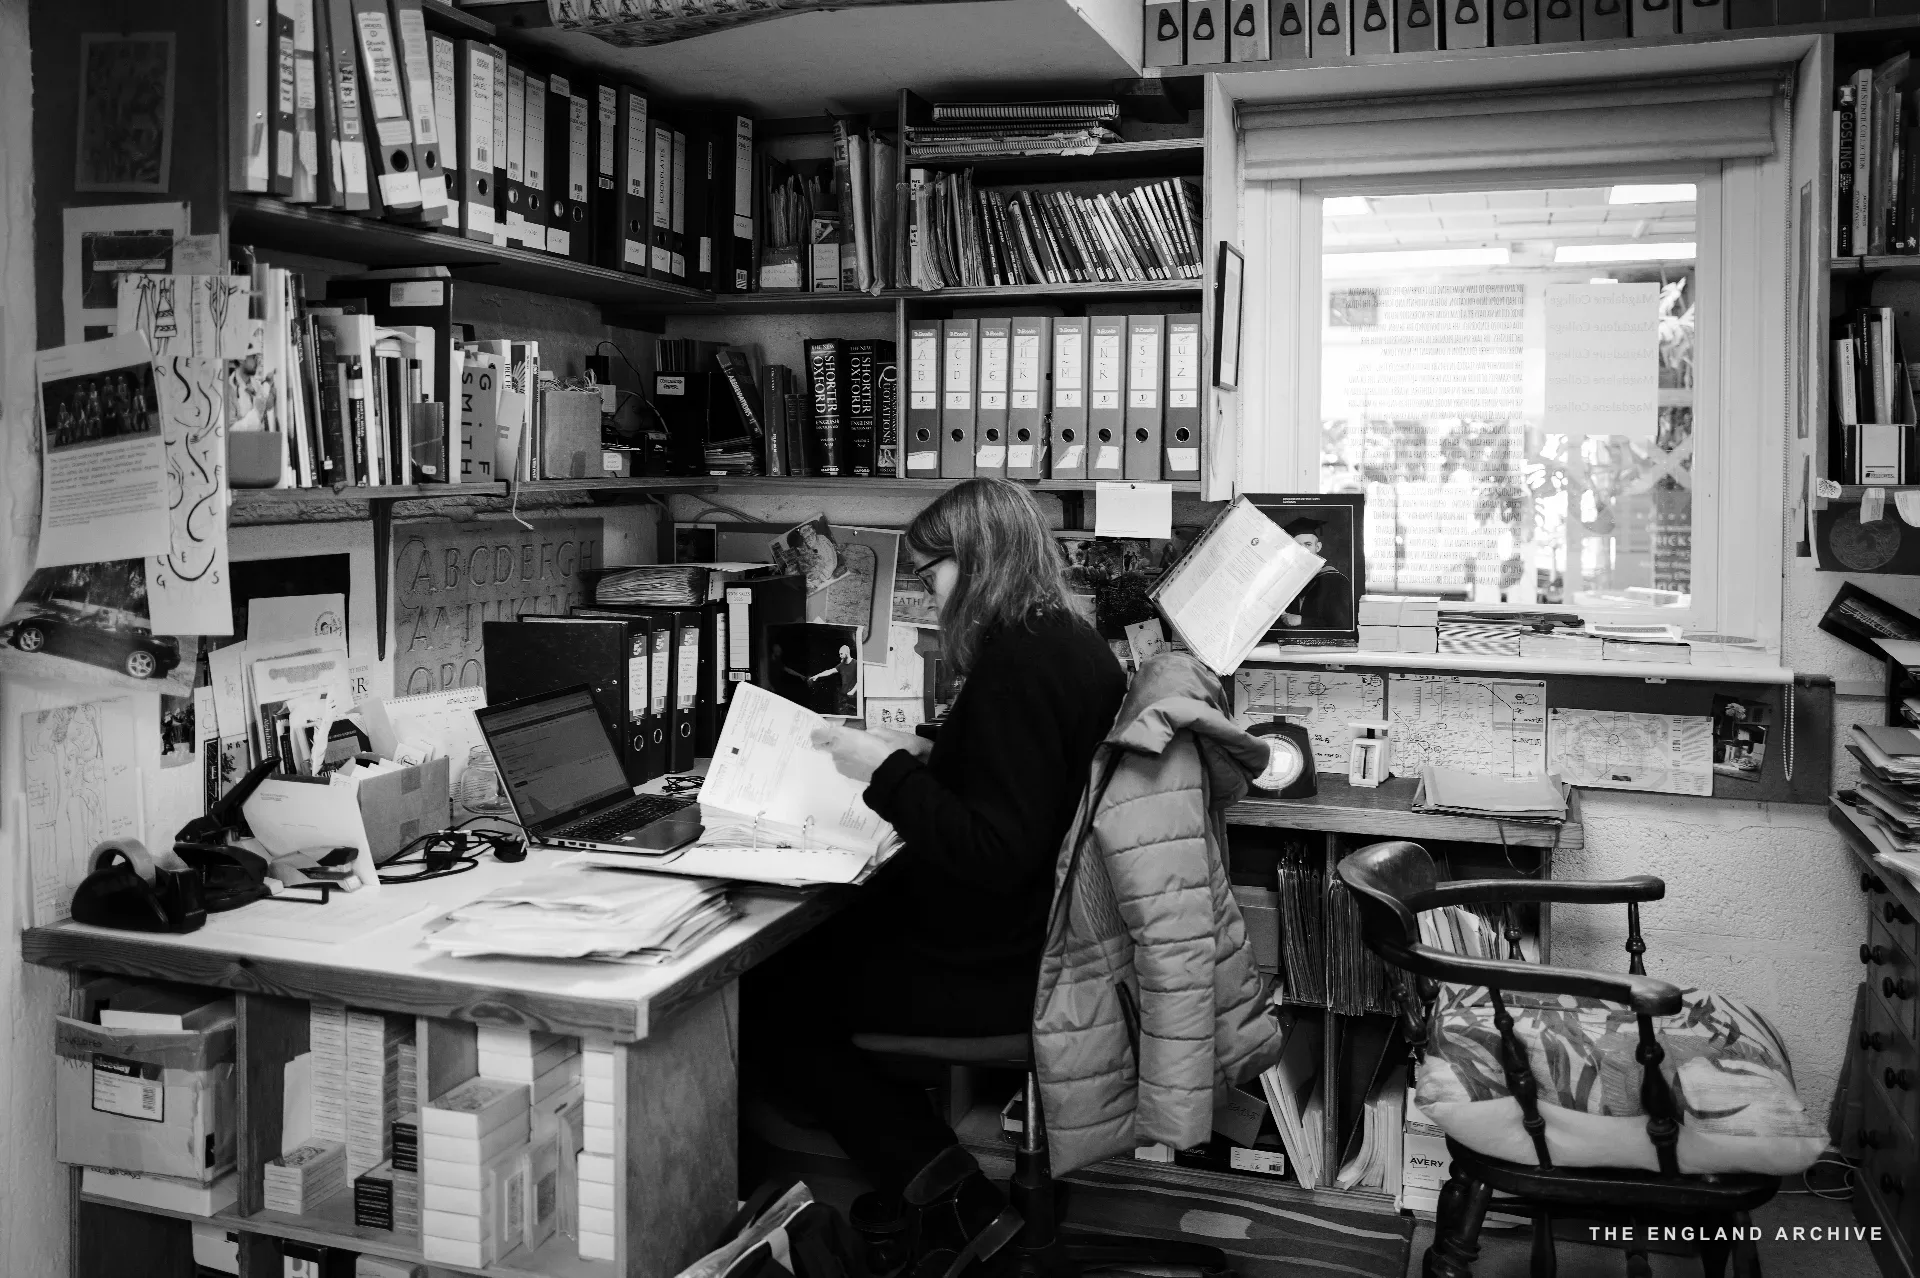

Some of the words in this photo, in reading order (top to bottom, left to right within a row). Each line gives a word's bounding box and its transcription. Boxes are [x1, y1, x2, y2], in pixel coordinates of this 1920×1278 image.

[1840, 111, 1854, 169] GOSLING
[918, 349, 927, 360] A
[813, 356, 826, 414] OXFORD
[825, 355, 838, 413] SHORTER
[850, 357, 861, 414] OXFORD
[861, 356, 872, 414] SHORTER
[1409, 1157, 1445, 1168] AVERY
